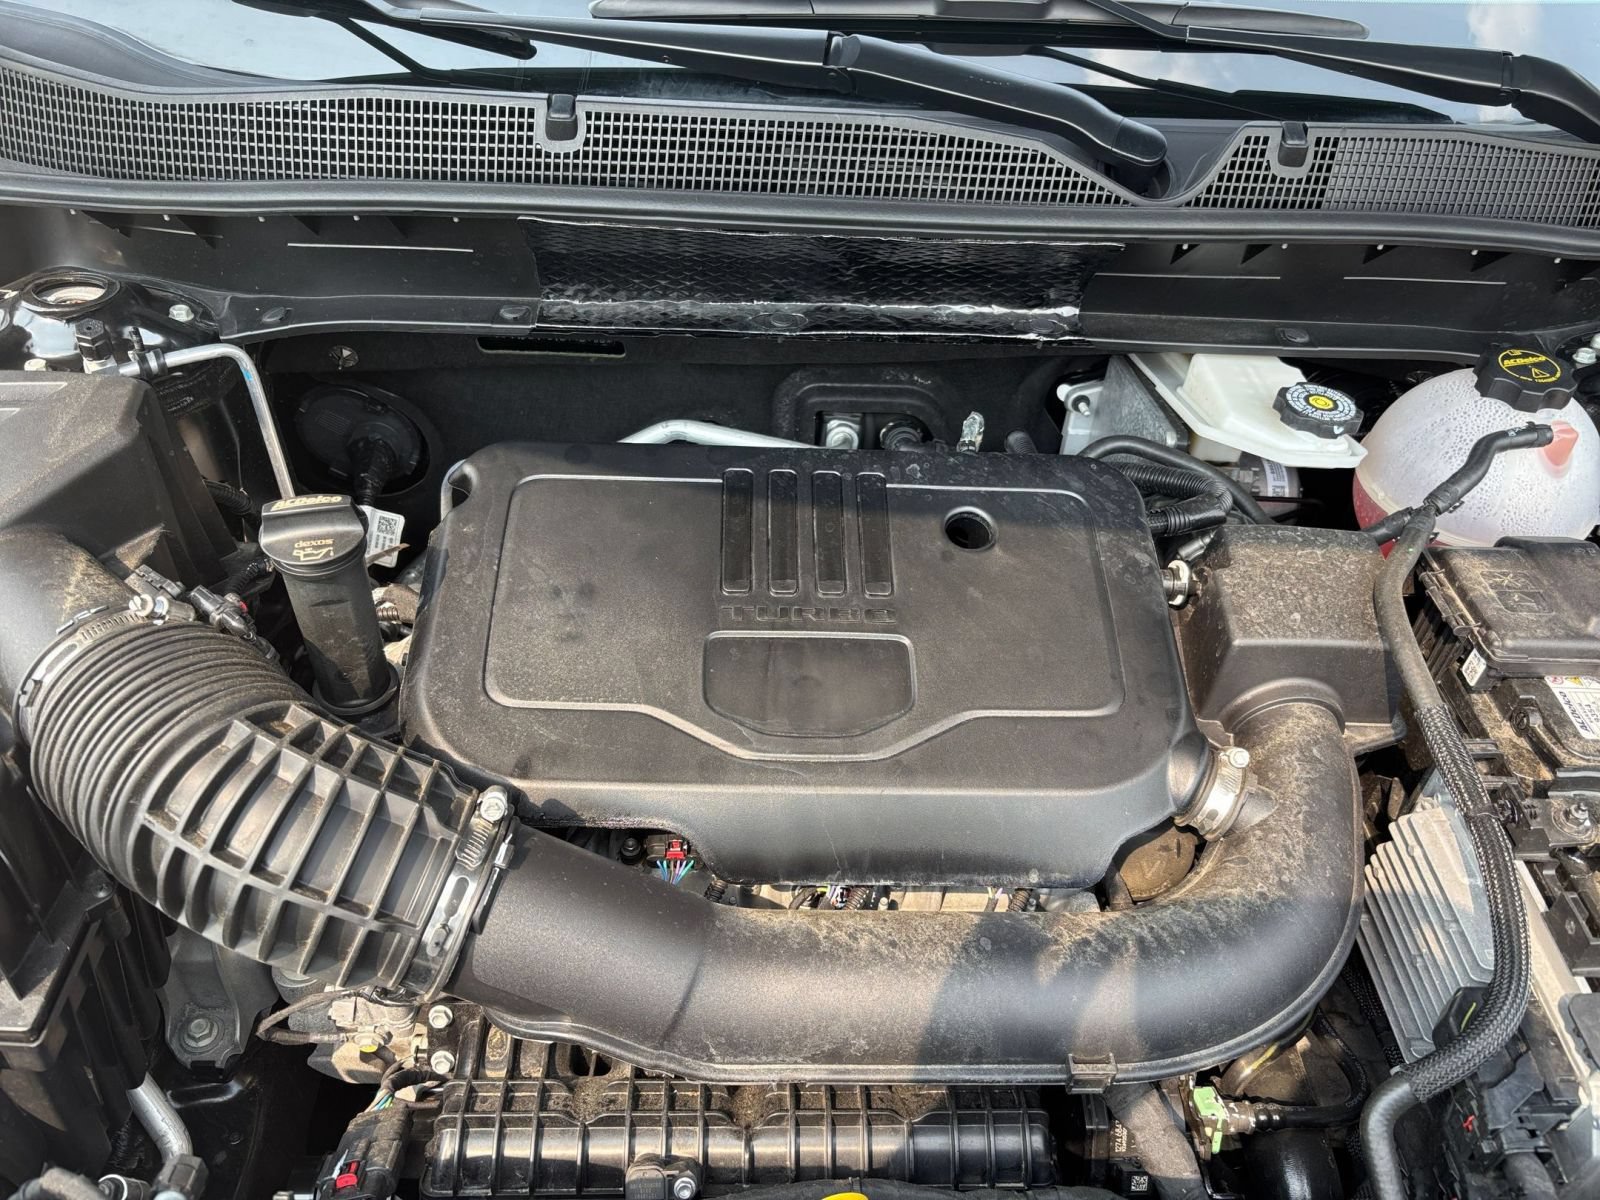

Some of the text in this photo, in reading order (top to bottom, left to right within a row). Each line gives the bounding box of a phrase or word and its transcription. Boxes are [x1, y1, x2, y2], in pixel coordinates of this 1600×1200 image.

[270, 495, 342, 511] ACDelco
[294, 539, 335, 548] dexos
[721, 606, 897, 624] TURBO
[1558, 690, 1591, 733] ACDelco
